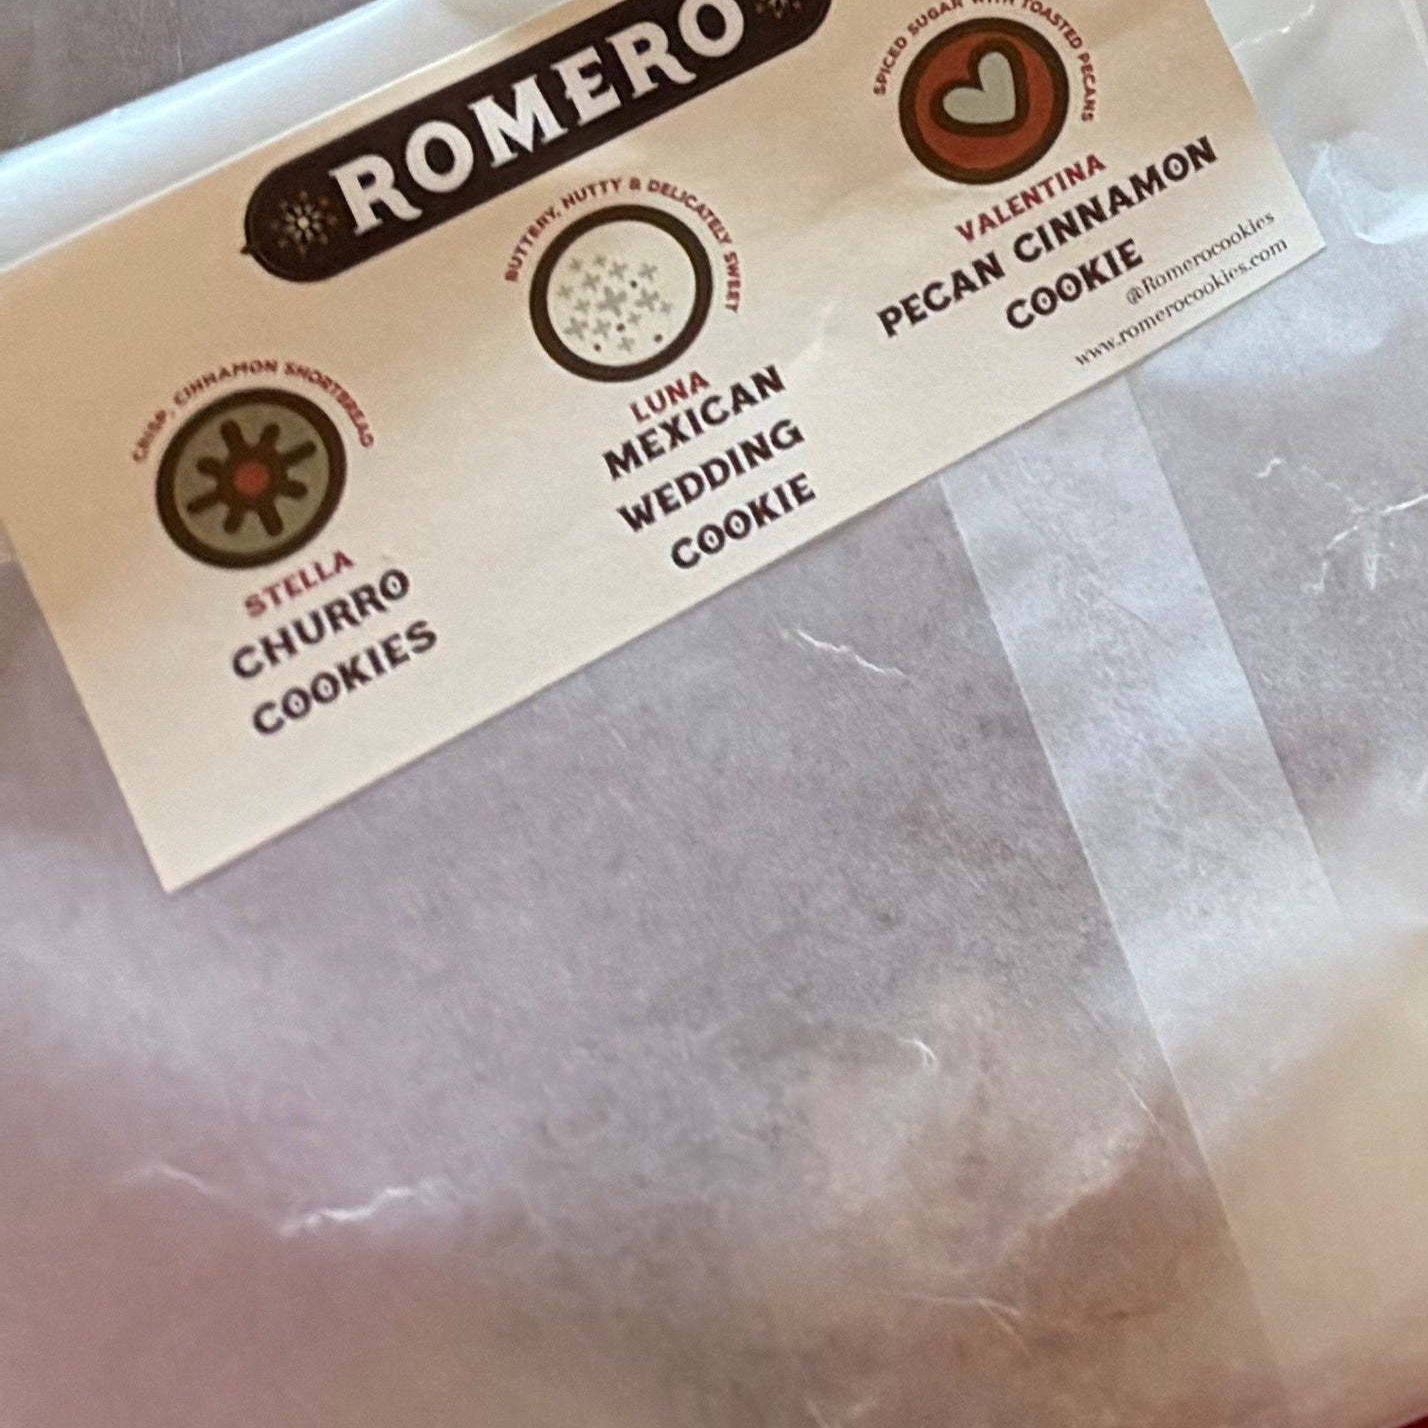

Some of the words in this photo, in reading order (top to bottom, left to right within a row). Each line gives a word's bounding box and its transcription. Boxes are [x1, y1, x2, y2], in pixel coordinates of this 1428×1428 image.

[872, 35, 908, 96] SPICED
[1077, 51, 1097, 122] PECANS
[560, 177, 622, 210] NUTTY
[646, 178, 733, 244] DELICATELY
[723, 251, 741, 314] SWEET
[876, 250, 1005, 339] PECAN
[1013, 135, 1218, 262] CINNAMON
[955, 154, 1107, 242] VALENTINA
[1006, 237, 1144, 329] COOKIE
[1075, 238, 1289, 366] www.romerocookies.com
[1126, 211, 1276, 305] @Romerocookies
[602, 363, 786, 482] MEXICAN
[629, 370, 711, 424] LUNA
[615, 418, 805, 533] WEDDING
[669, 473, 816, 569] COOKIE
[232, 570, 410, 676] CHURRO
[243, 550, 355, 617] STELLA
[252, 623, 437, 731] COOKIES
